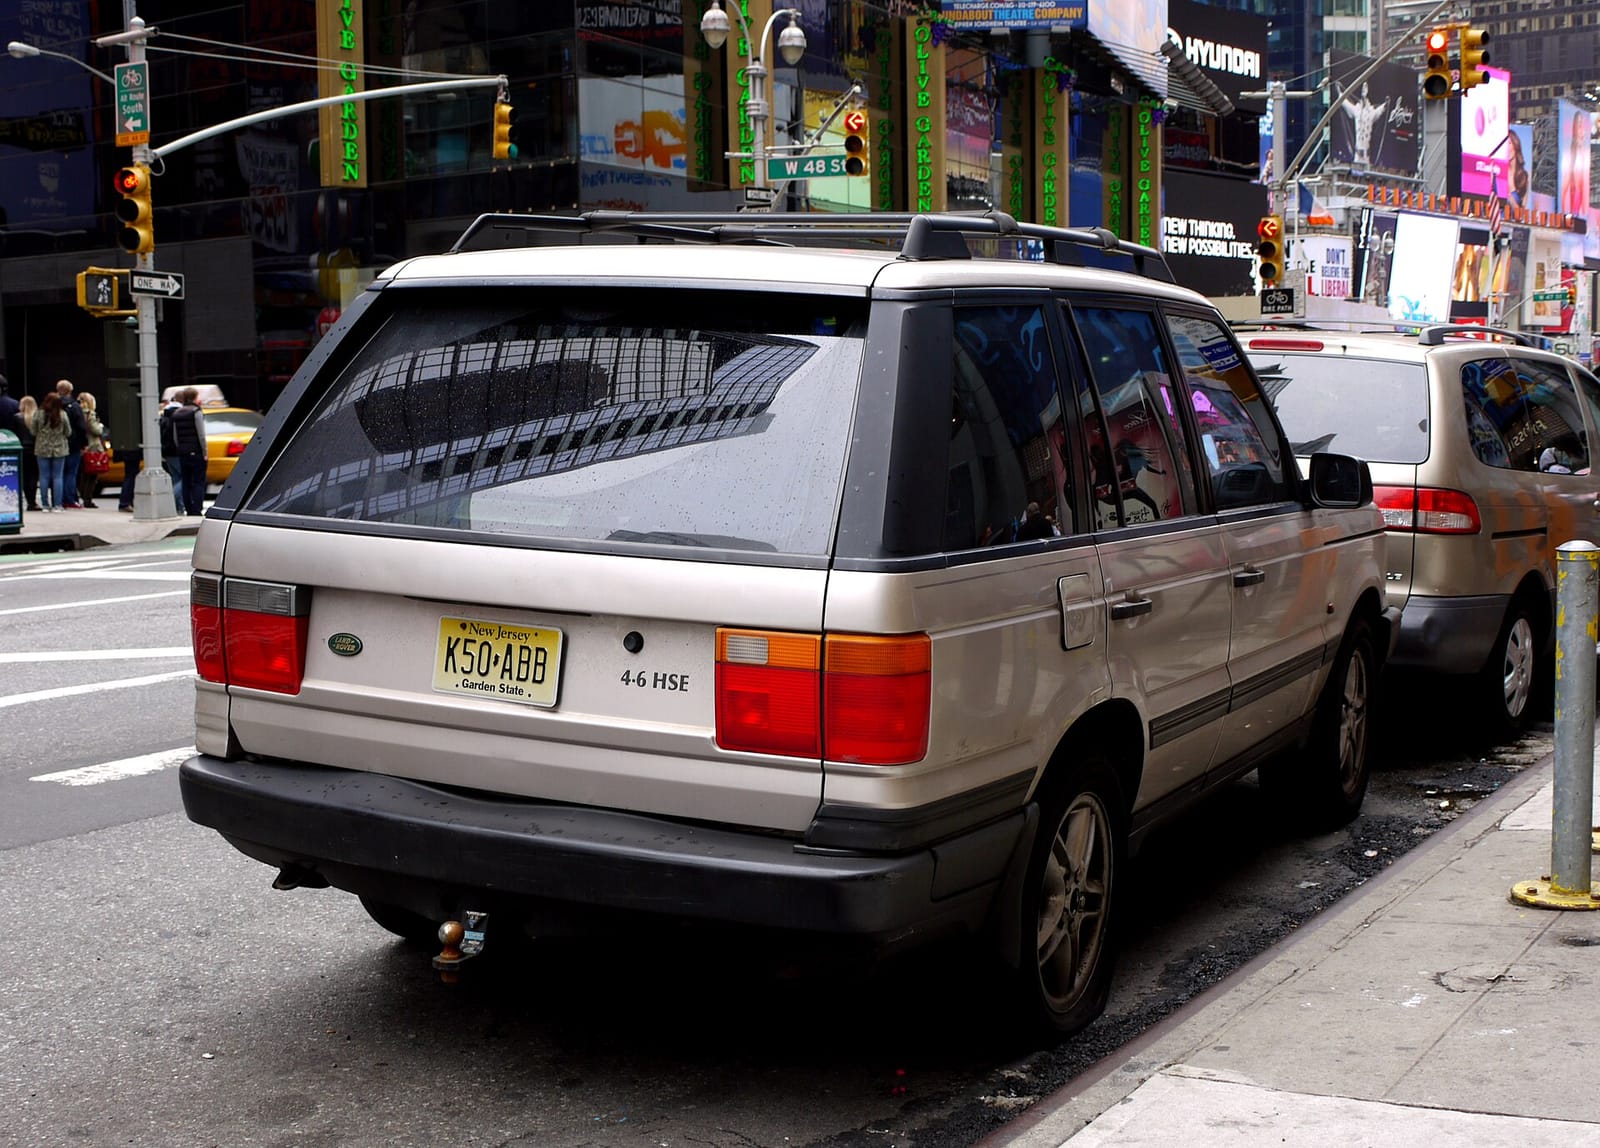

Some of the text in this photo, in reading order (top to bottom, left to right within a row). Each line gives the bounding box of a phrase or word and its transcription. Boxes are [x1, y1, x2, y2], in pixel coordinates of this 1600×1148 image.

[993, 9, 1033, 20] THEATRE
[1034, 7, 1083, 19] COMPANY
[1185, 36, 1260, 79] HYUNDAI
[122, 103, 143, 114] South
[1042, 74, 1057, 145] OLIVE
[339, 61, 359, 182] GARDEN
[914, 26, 932, 213] OLIVE GARDEN
[1138, 111, 1151, 173] OLIVE
[785, 161, 798, 176] W
[803, 160, 826, 174] 48
[1163, 216, 1187, 236] NEW
[1163, 236, 1187, 255] NEW
[137, 278, 175, 290] ONE WAY
[1262, 304, 1292, 313] BIKE PATH
[468, 622, 531, 644] New Jersey
[335, 643, 356, 652] ROVER
[461, 678, 524, 696] Garden State
[653, 672, 689, 692] HSE
